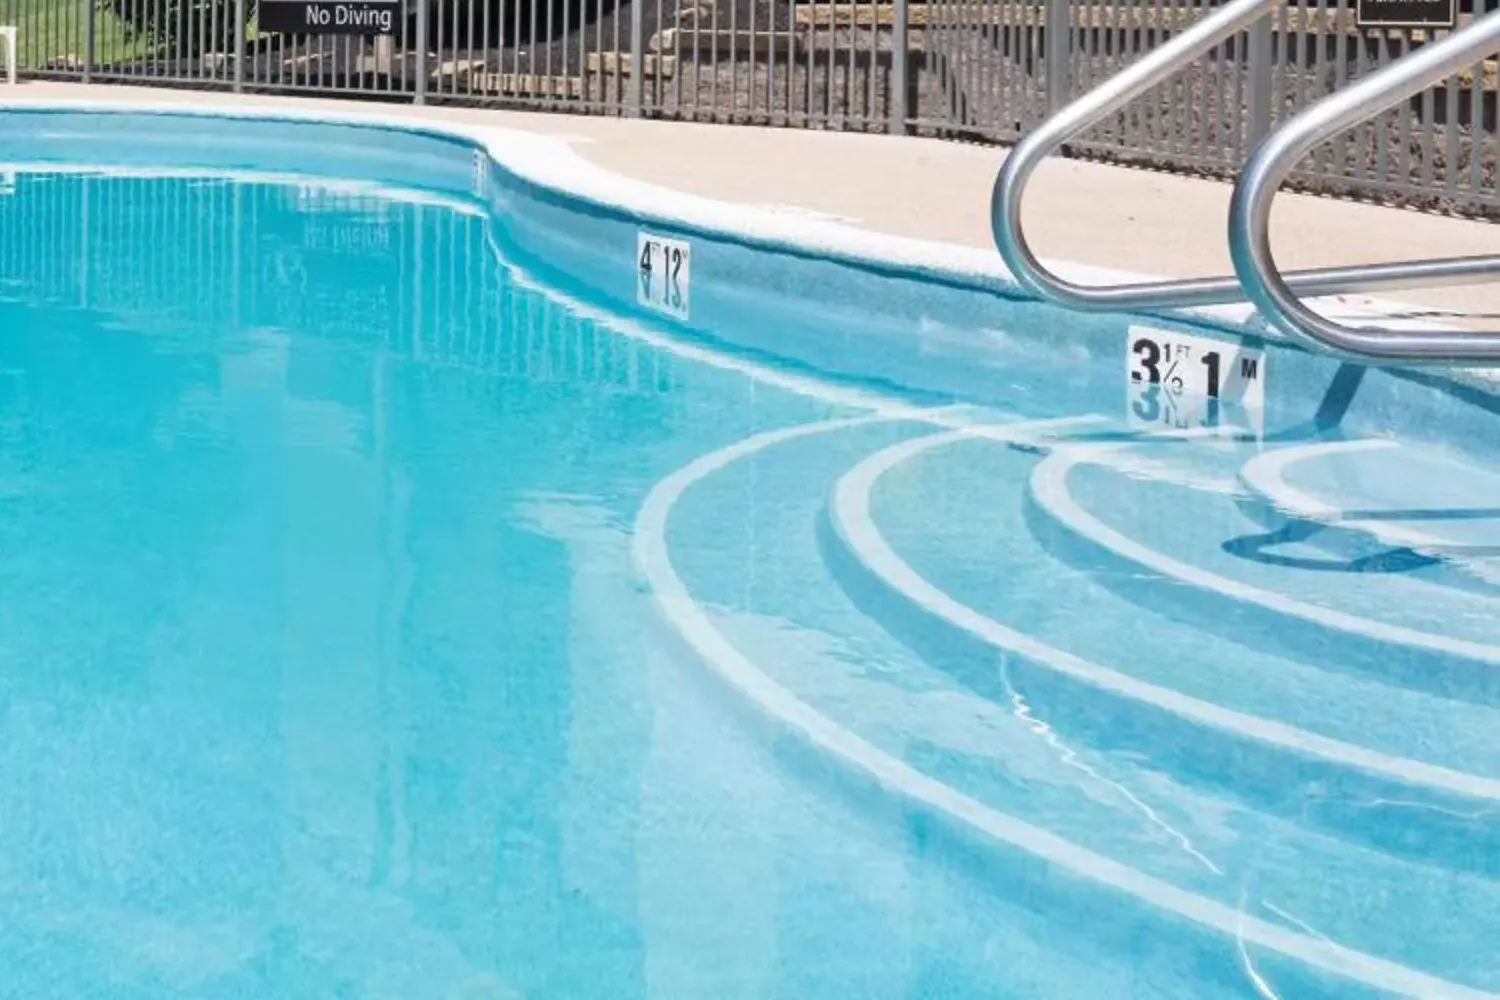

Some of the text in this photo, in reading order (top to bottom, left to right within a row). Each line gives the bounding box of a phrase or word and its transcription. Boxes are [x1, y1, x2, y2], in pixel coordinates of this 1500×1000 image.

[305, 4, 392, 31] No Diving
[640, 240, 652, 271] 4
[1131, 338, 1161, 385] 3
[1201, 351, 1220, 398] 1
[1241, 358, 1257, 379] M
